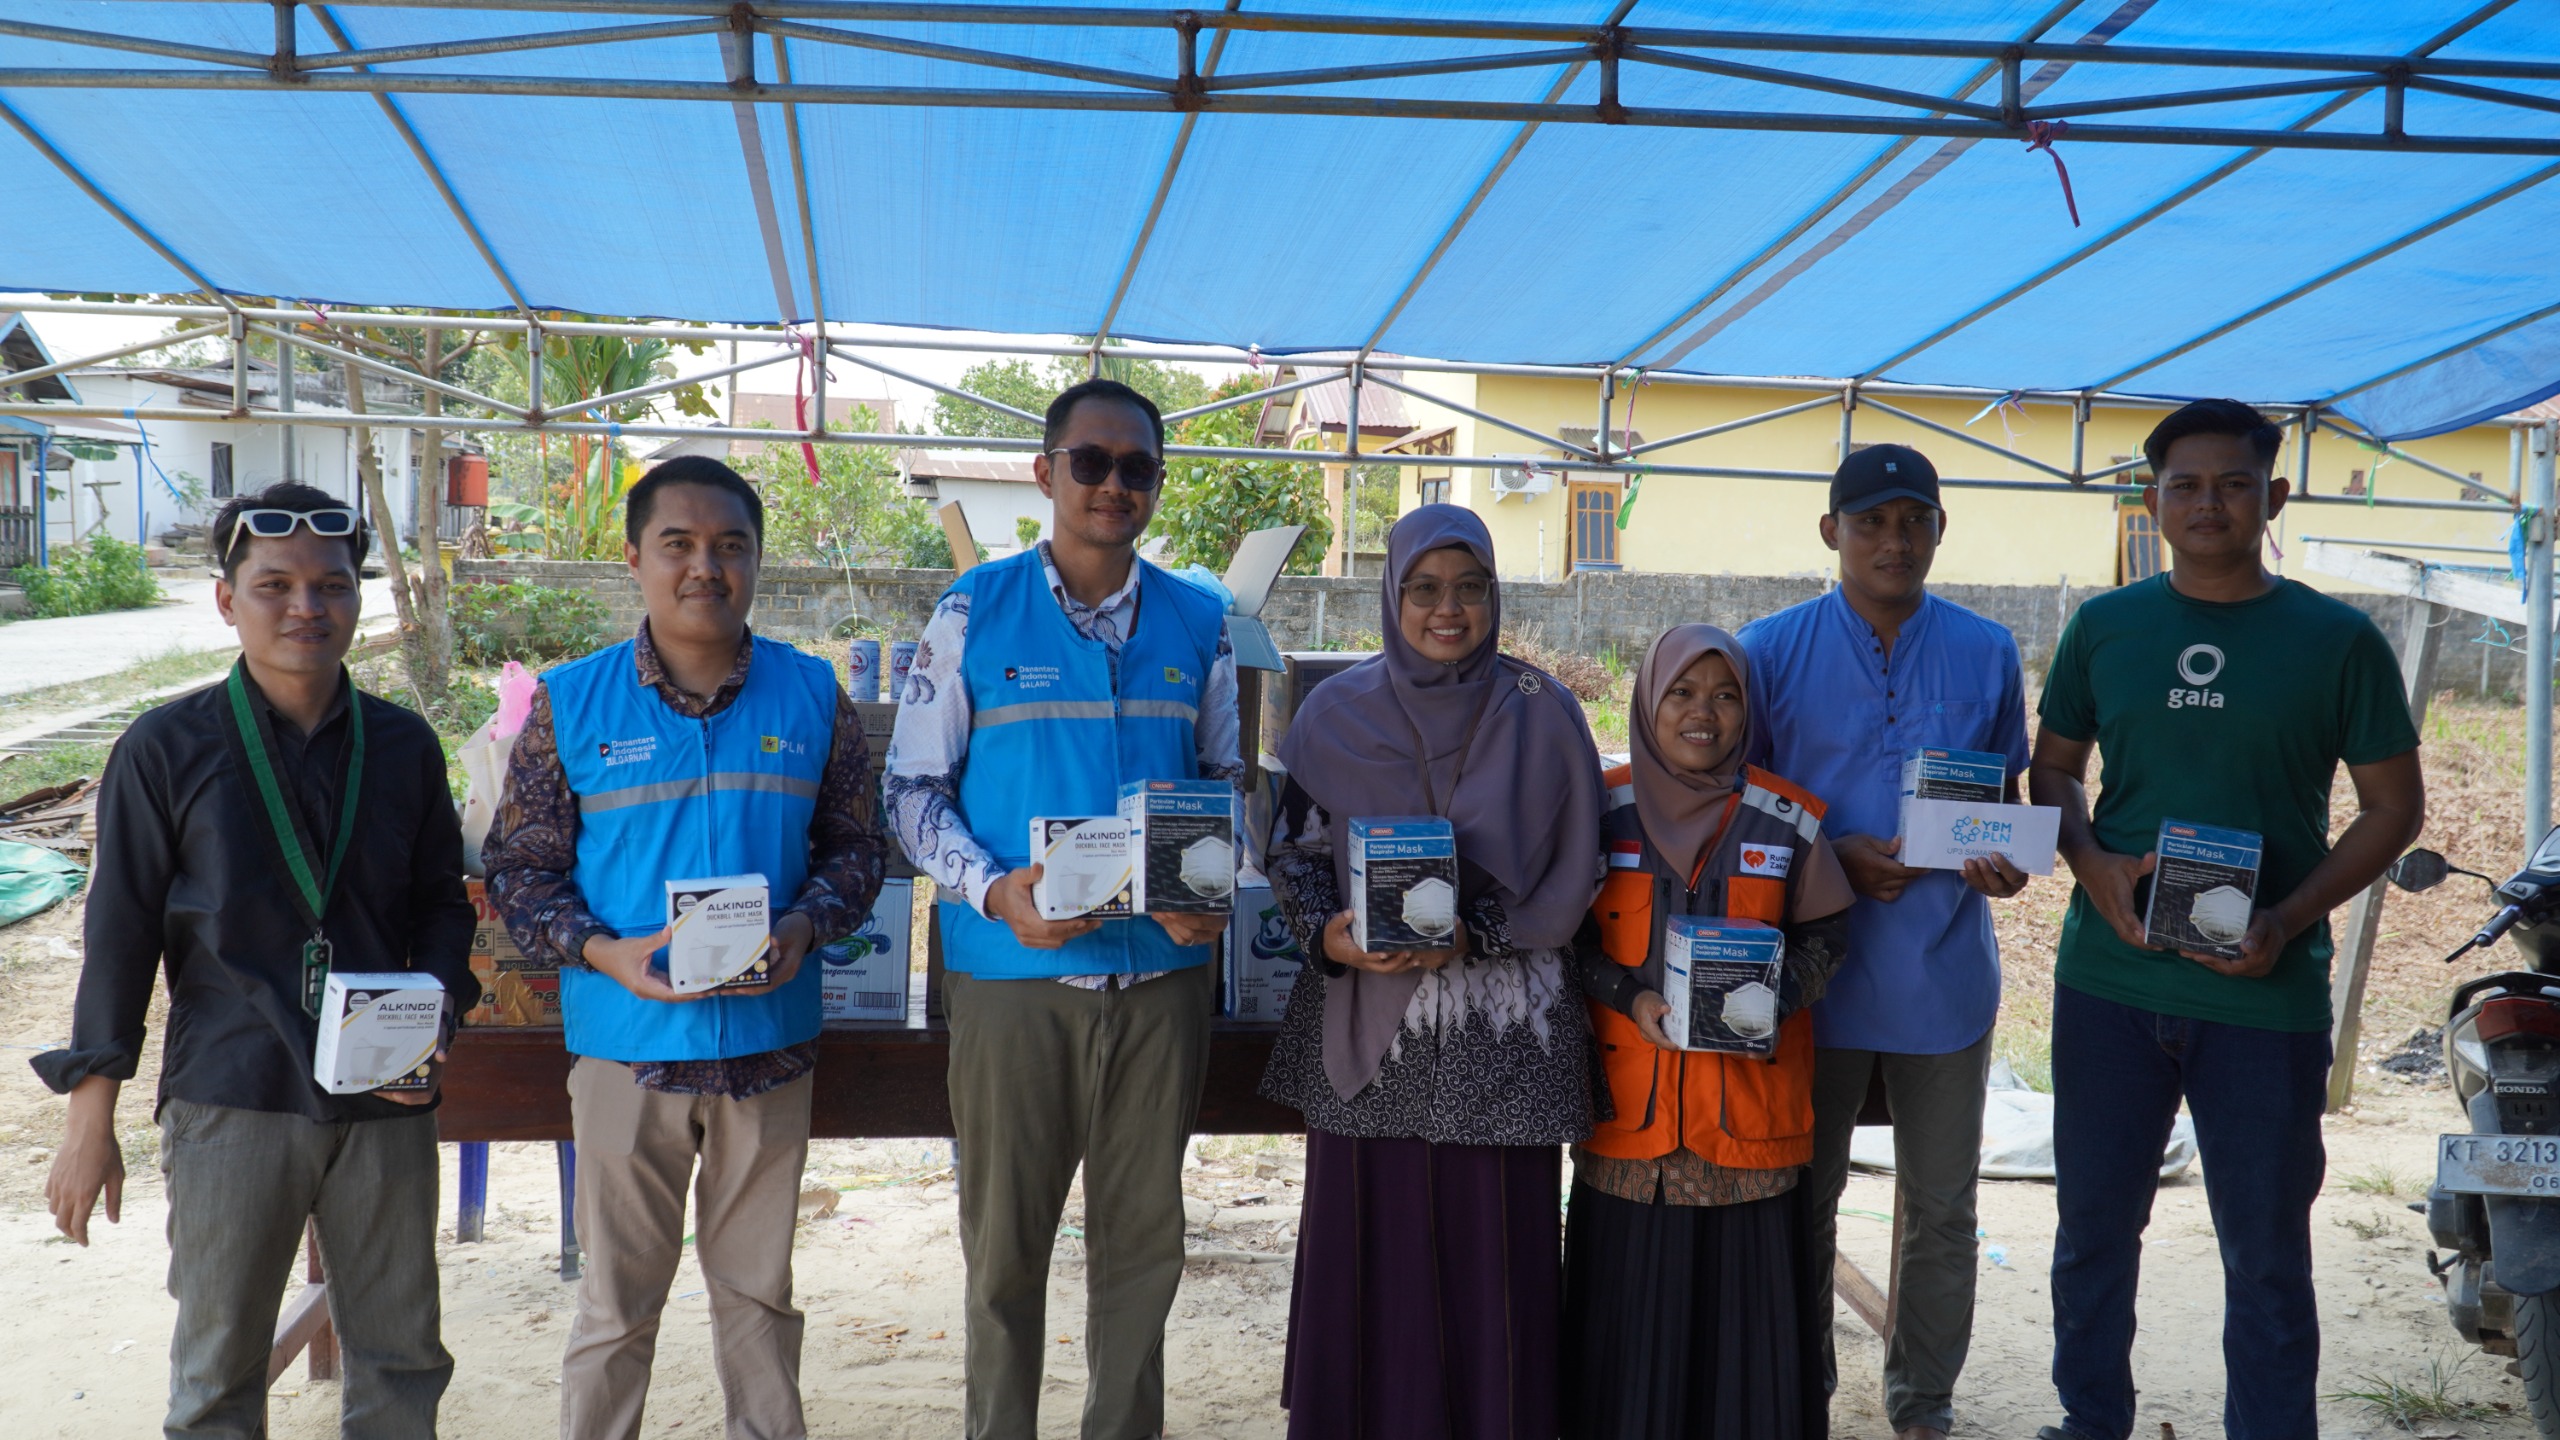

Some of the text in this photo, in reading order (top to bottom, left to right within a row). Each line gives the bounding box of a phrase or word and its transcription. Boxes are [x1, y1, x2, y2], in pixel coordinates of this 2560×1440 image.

[1018, 665, 1059, 673] Danantara
[1019, 680, 1051, 689] GALANG
[1180, 672, 1198, 688] PLN
[2167, 687, 2225, 709] gaia
[611, 736, 656, 748] Danantara
[779, 740, 805, 755] PLN
[1949, 767, 1976, 779] Mask
[1176, 800, 1204, 811] Mask
[1982, 820, 2012, 833] YBM
[1076, 831, 1126, 841] ALKINDO
[1982, 831, 2011, 844] PLN
[1397, 843, 1424, 854] Mask
[1946, 848, 1963, 856] UP3
[2196, 847, 2225, 860] Mask
[707, 900, 763, 912] ALKINDO
[1723, 947, 1749, 957] Mask
[822, 992, 847, 1001] 00 ml
[379, 1003, 436, 1012] ALKINDO
[2494, 1085, 2548, 1095] HONDA
[2445, 1140, 2558, 1164] KT 3213
